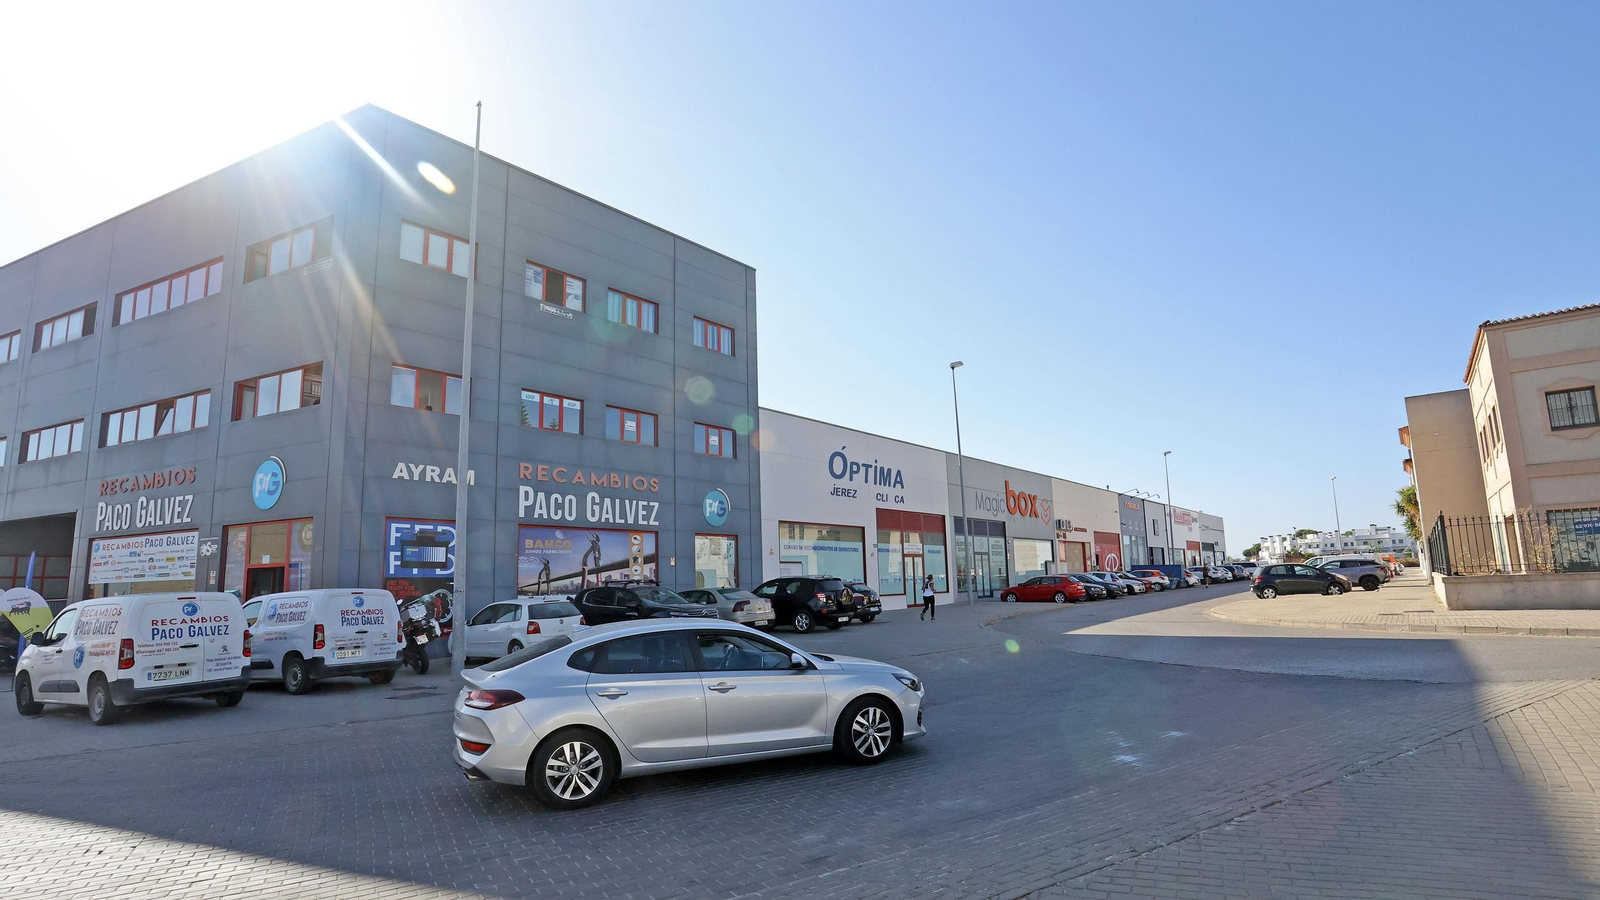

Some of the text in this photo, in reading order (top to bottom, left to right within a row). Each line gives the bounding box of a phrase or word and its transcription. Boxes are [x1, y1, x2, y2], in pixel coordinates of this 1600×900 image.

[99, 466, 197, 496] RECAMBIOS
[519, 462, 659, 493] RECAMBIOS
[830, 484, 858, 498] JEREZ
[518, 486, 660, 526] PACO GALVEZ
[975, 480, 1039, 518] Magic box
[95, 494, 194, 532] PACO GALVEZ
[102, 536, 195, 552] RECAMBIOS PACO GALVEZ
[279, 600, 308, 610] RECAMBIOS
[82, 608, 122, 618] RECAMBIOS
[276, 611, 306, 623] PACO GALVEZ
[75, 620, 118, 635] PACO GALVEZ
[152, 616, 229, 626] RECAMBIOS
[341, 616, 384, 626] PACO GALVEZ
[152, 625, 229, 640] PACO GALVEZ
